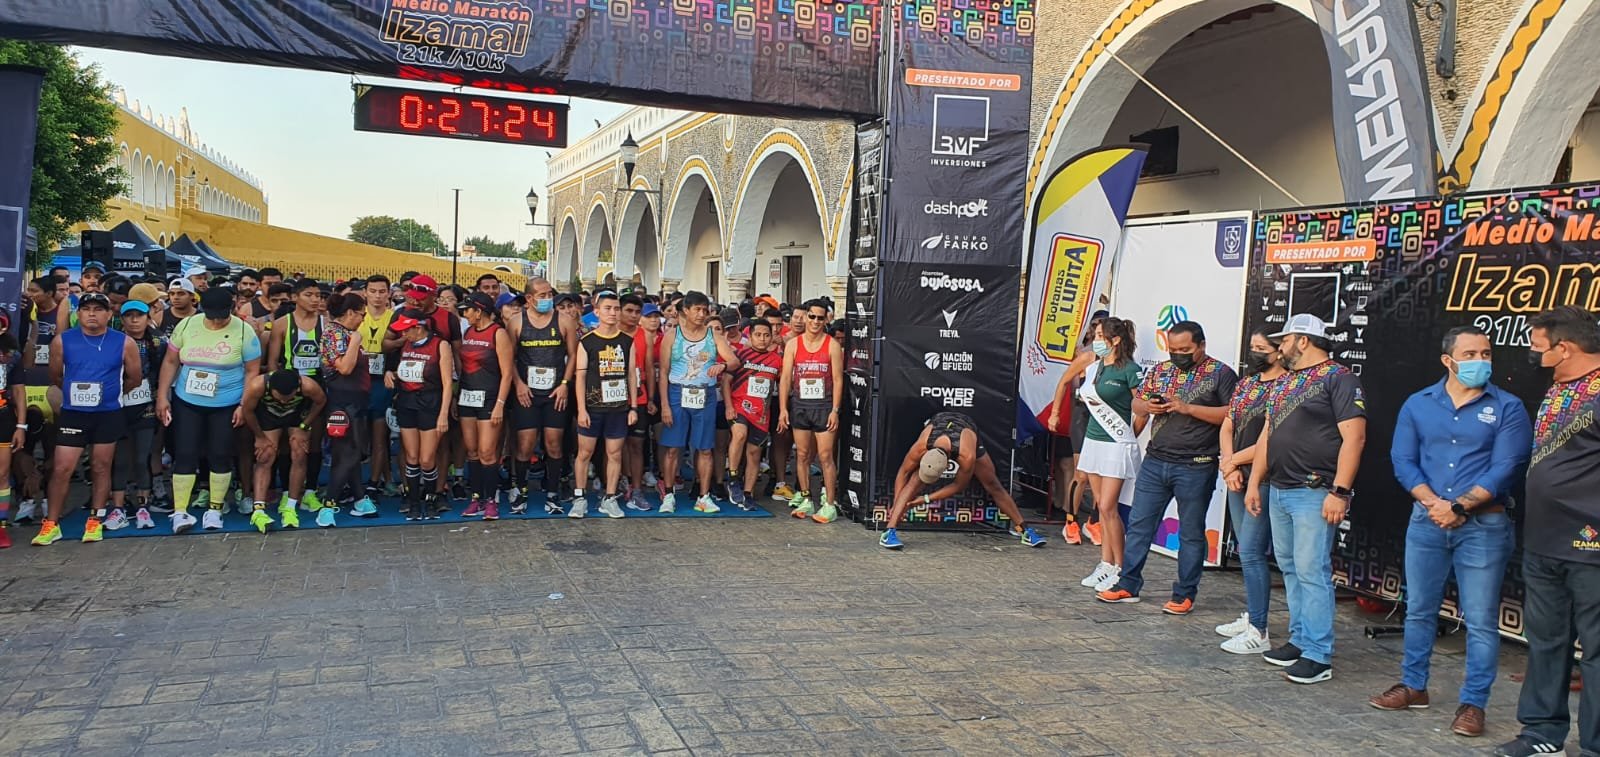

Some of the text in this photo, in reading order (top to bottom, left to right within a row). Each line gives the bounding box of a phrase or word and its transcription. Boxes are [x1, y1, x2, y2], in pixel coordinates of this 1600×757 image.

[454, 1, 529, 22] Maratón
[384, 9, 528, 55] Izamal
[402, 44, 444, 63] 21k
[465, 51, 505, 70] 10k
[914, 74, 1012, 88] PRESENTADO POR
[400, 95, 554, 139] 0:27:24
[930, 158, 987, 168] INVERSIONES
[1463, 217, 1554, 247] Medio
[944, 240, 988, 250] FARKO
[1273, 245, 1367, 260] PRESENTADO POR
[1046, 269, 1065, 323] Botanas
[1046, 246, 1088, 353] LA LUPITA
[942, 351, 973, 362] NACIÓN
[189, 379, 214, 392] 1260
[531, 376, 553, 385] 1257
[605, 389, 625, 398] 1002
[750, 385, 769, 395] 1502
[805, 387, 820, 395] 219
[920, 387, 975, 398] POWER
[73, 393, 97, 402] 1695
[943, 397, 974, 407] ADE
[1097, 409, 1124, 436] FARKO
